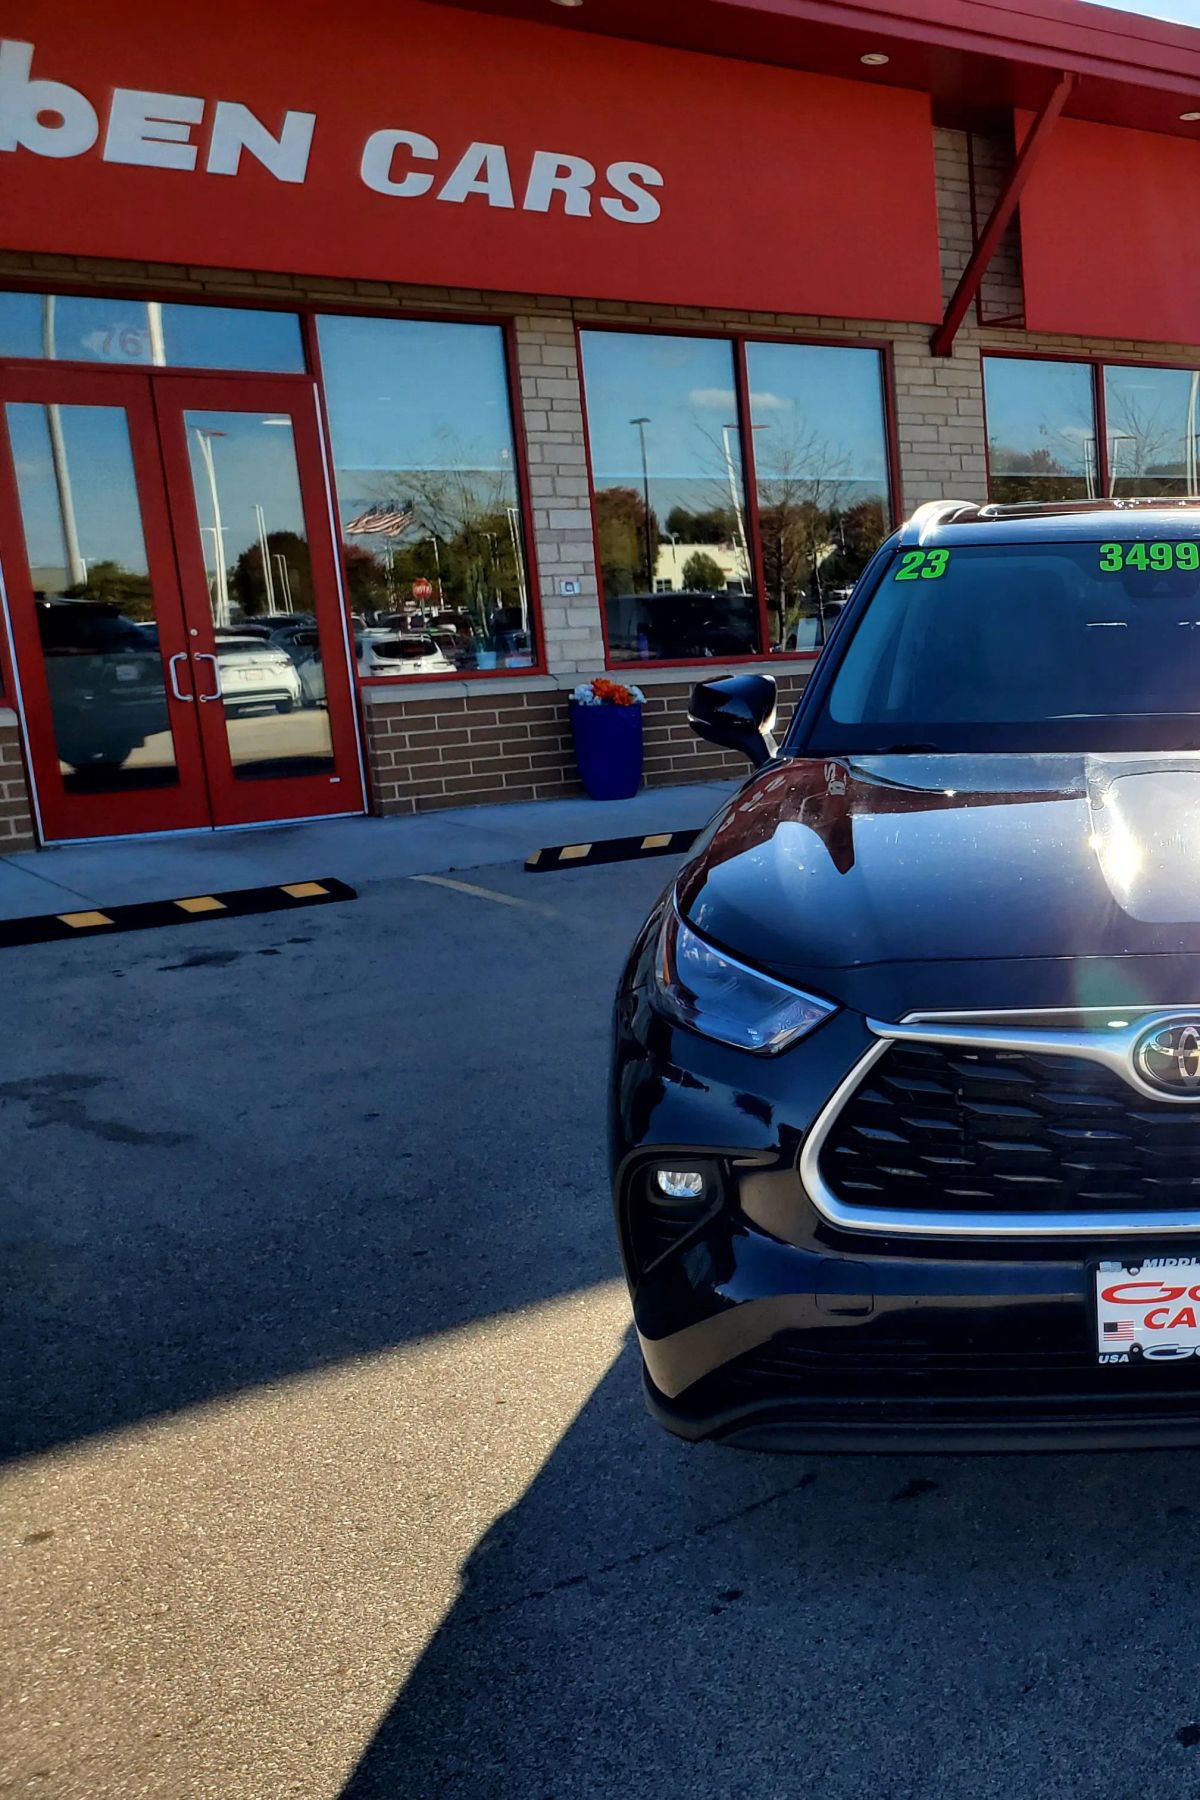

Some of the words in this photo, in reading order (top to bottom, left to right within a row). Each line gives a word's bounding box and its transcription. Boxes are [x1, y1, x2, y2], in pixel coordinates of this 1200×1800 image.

[360, 128, 664, 224] CARS
[895, 549, 950, 580] 23
[1099, 1353, 1130, 1364] USA
